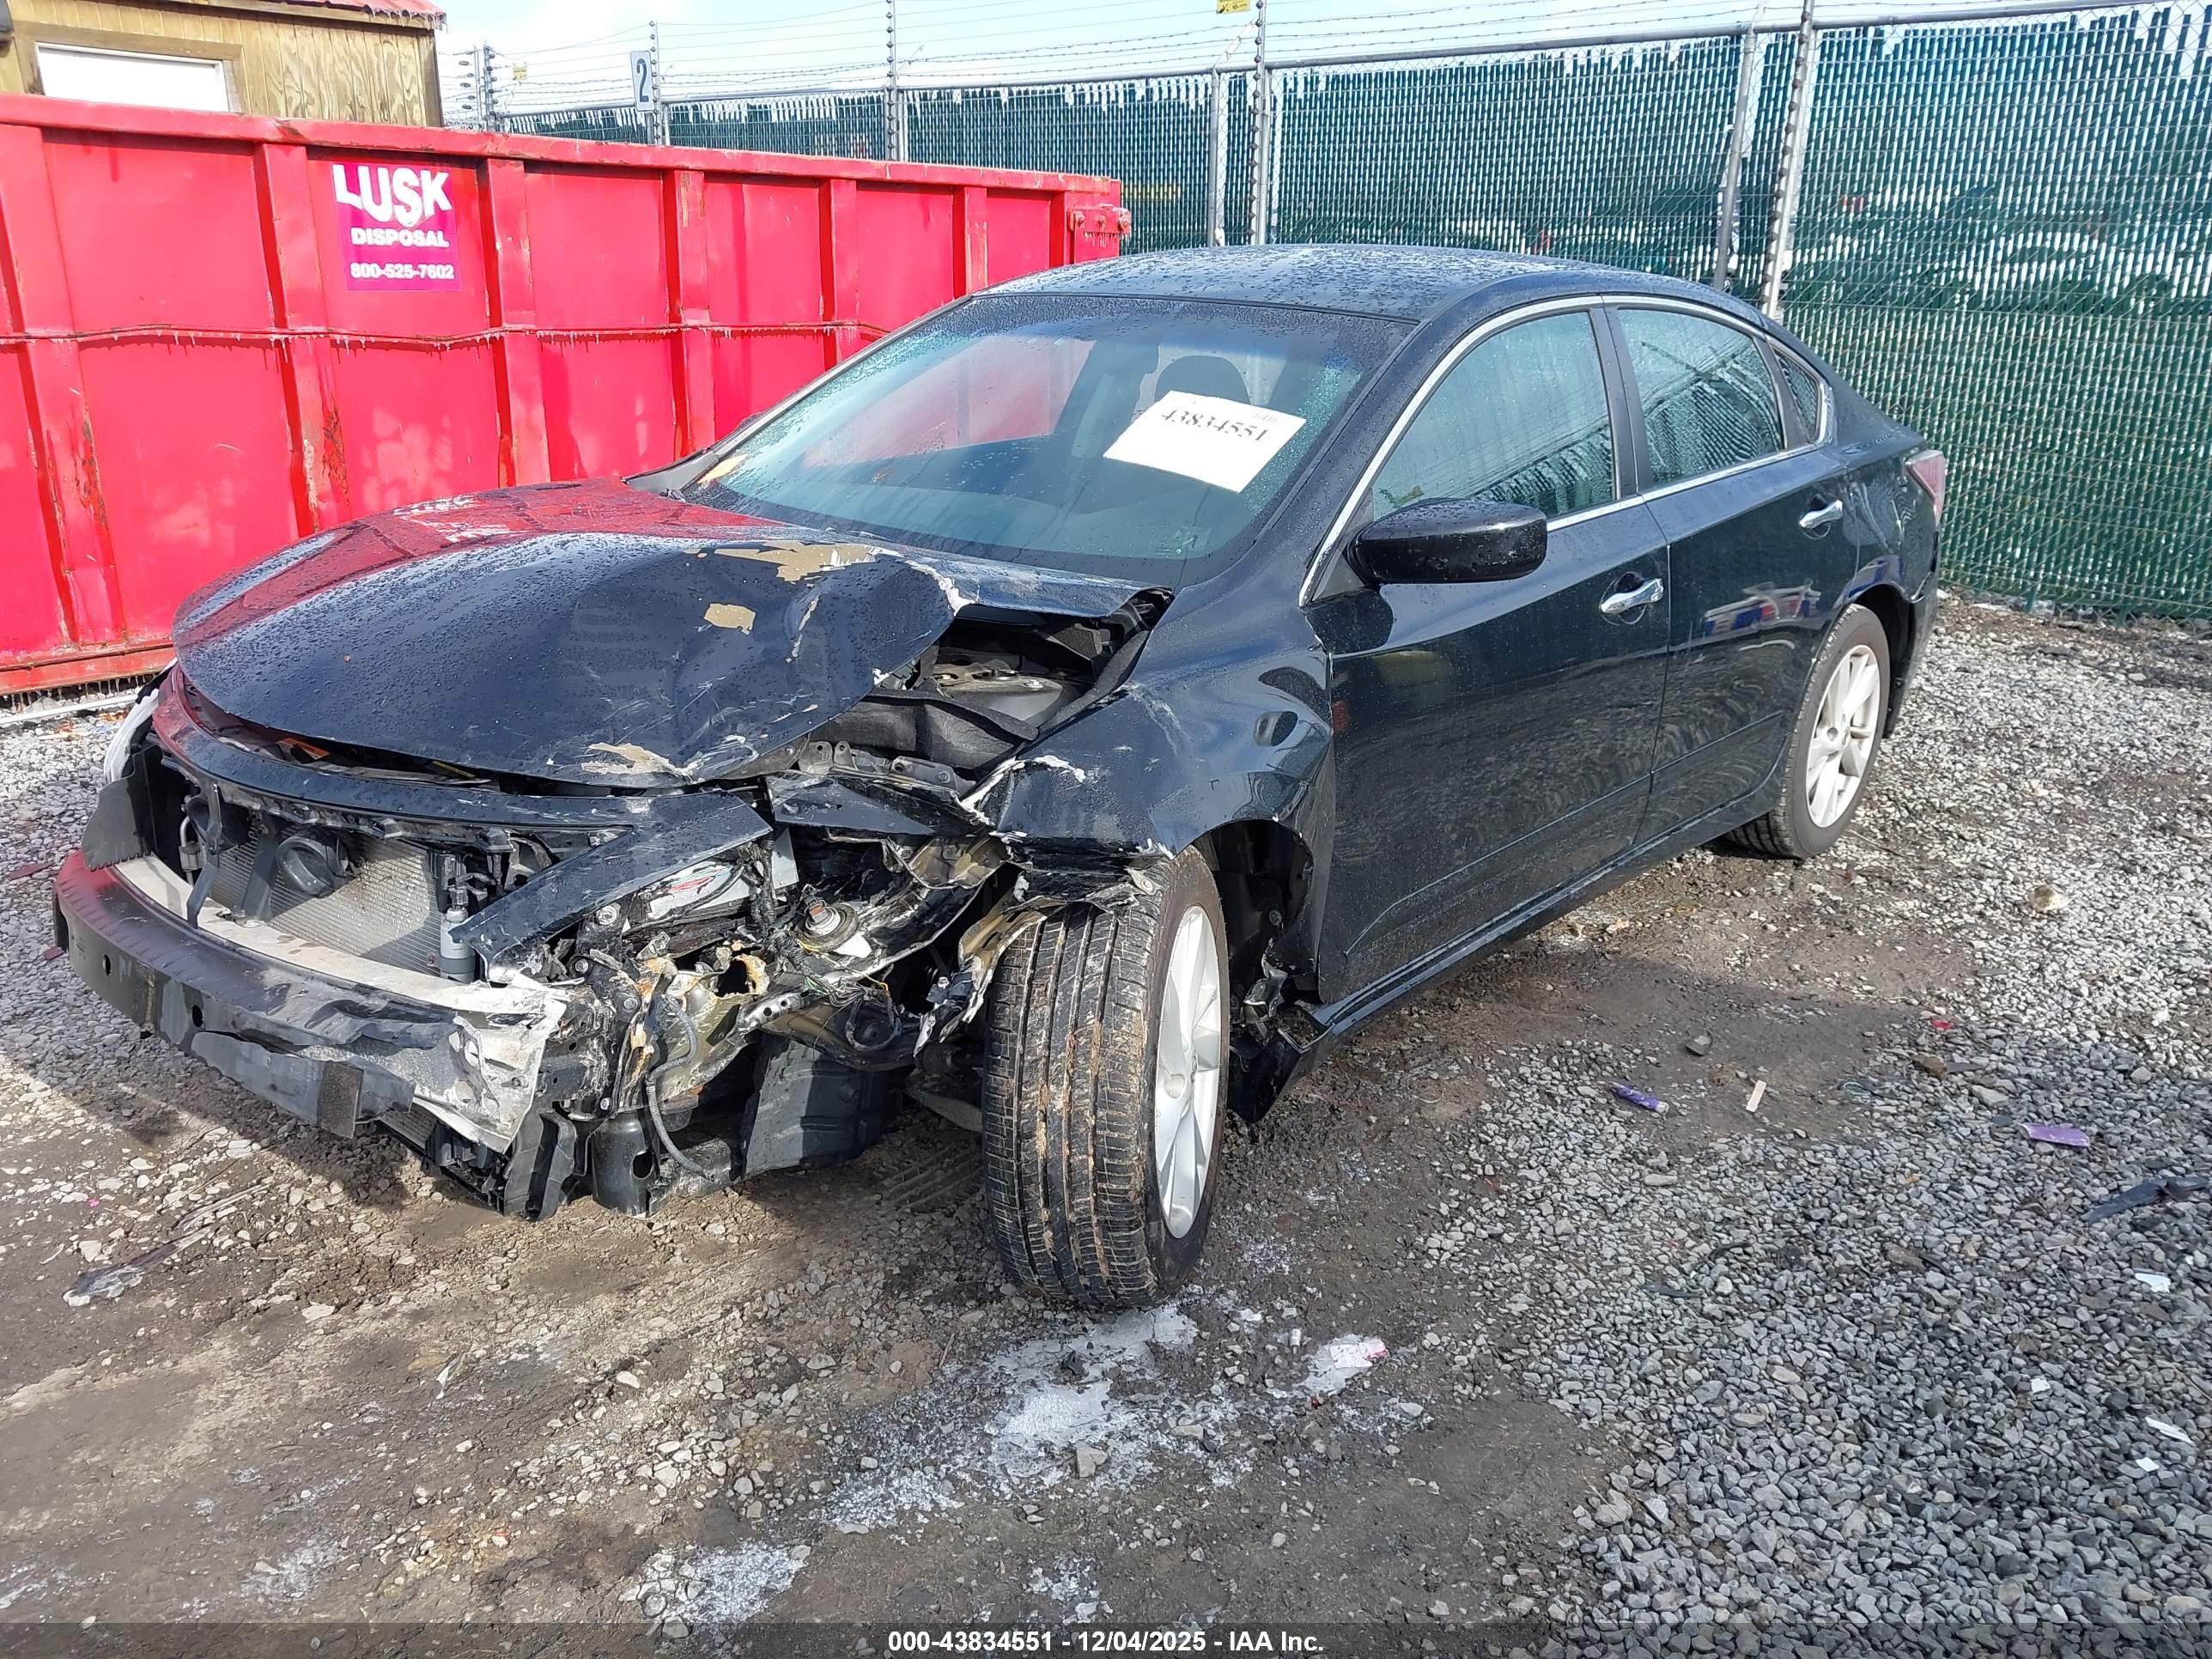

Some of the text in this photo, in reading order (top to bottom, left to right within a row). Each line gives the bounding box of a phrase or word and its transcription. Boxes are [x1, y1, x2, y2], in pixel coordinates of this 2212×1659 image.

[635, 58, 649, 103] 2
[331, 164, 453, 228] LUSK
[350, 227, 450, 247] DISPOSAL
[349, 262, 455, 280] 800-525-7602
[1161, 410, 1268, 441] 43834551
